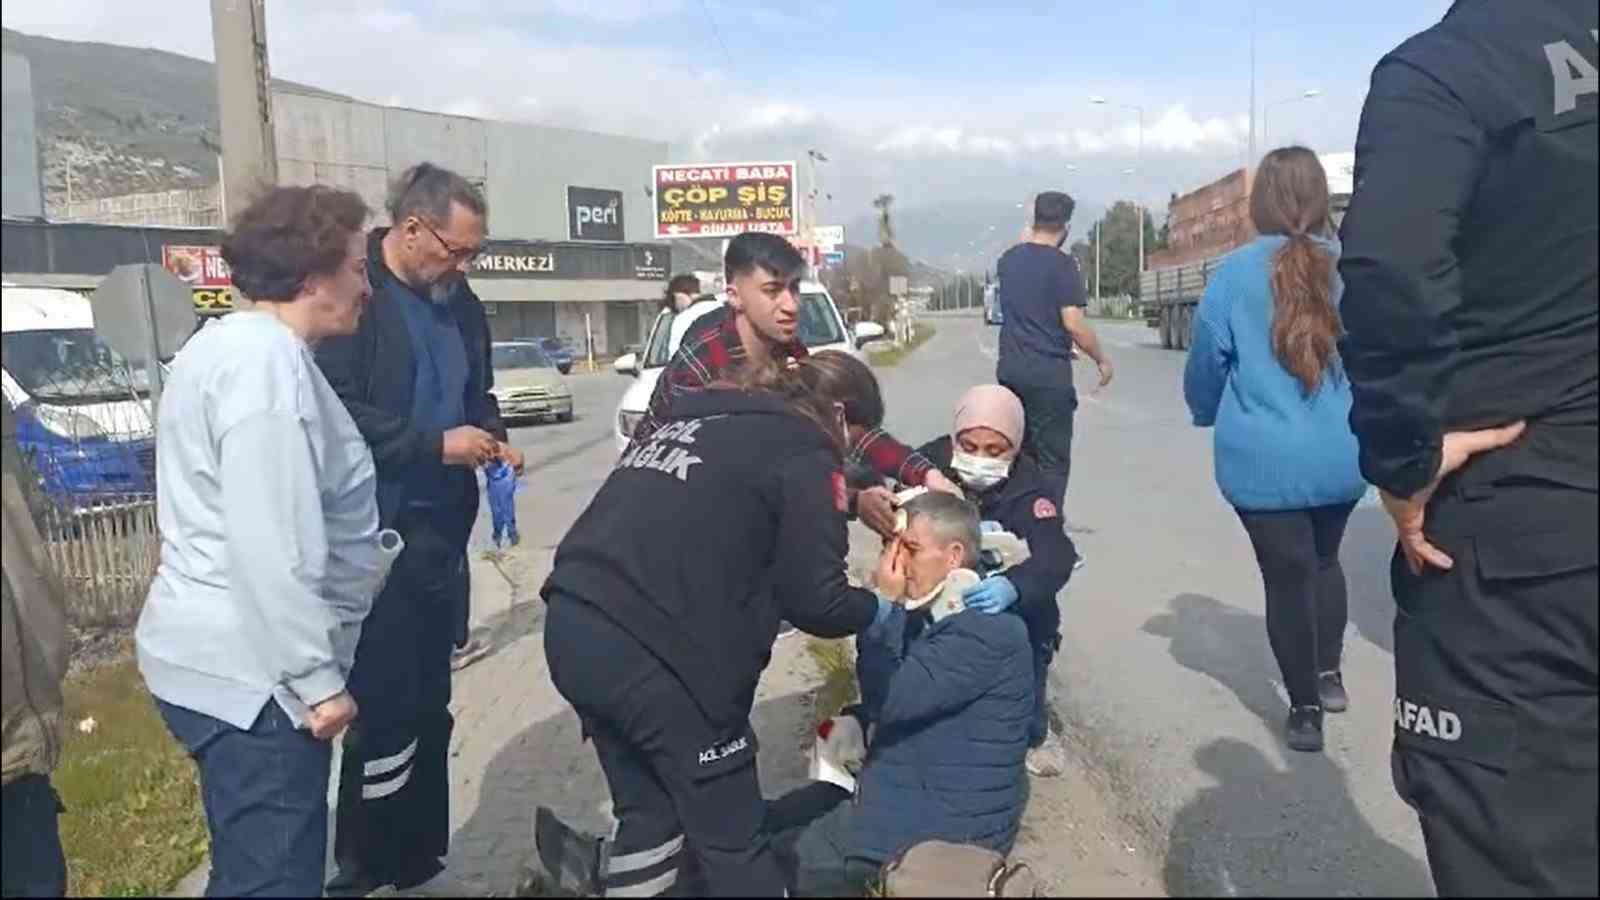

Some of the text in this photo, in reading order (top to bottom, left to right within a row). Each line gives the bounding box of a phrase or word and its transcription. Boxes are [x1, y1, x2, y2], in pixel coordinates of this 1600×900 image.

[735, 166, 788, 179] BABA
[664, 181, 786, 208] ÇÖP ŞİŞ
[575, 198, 618, 236] peri
[661, 208, 692, 222] KÖFTE
[477, 252, 554, 271] MERKEZİ
[1393, 698, 1462, 741] AFAD
